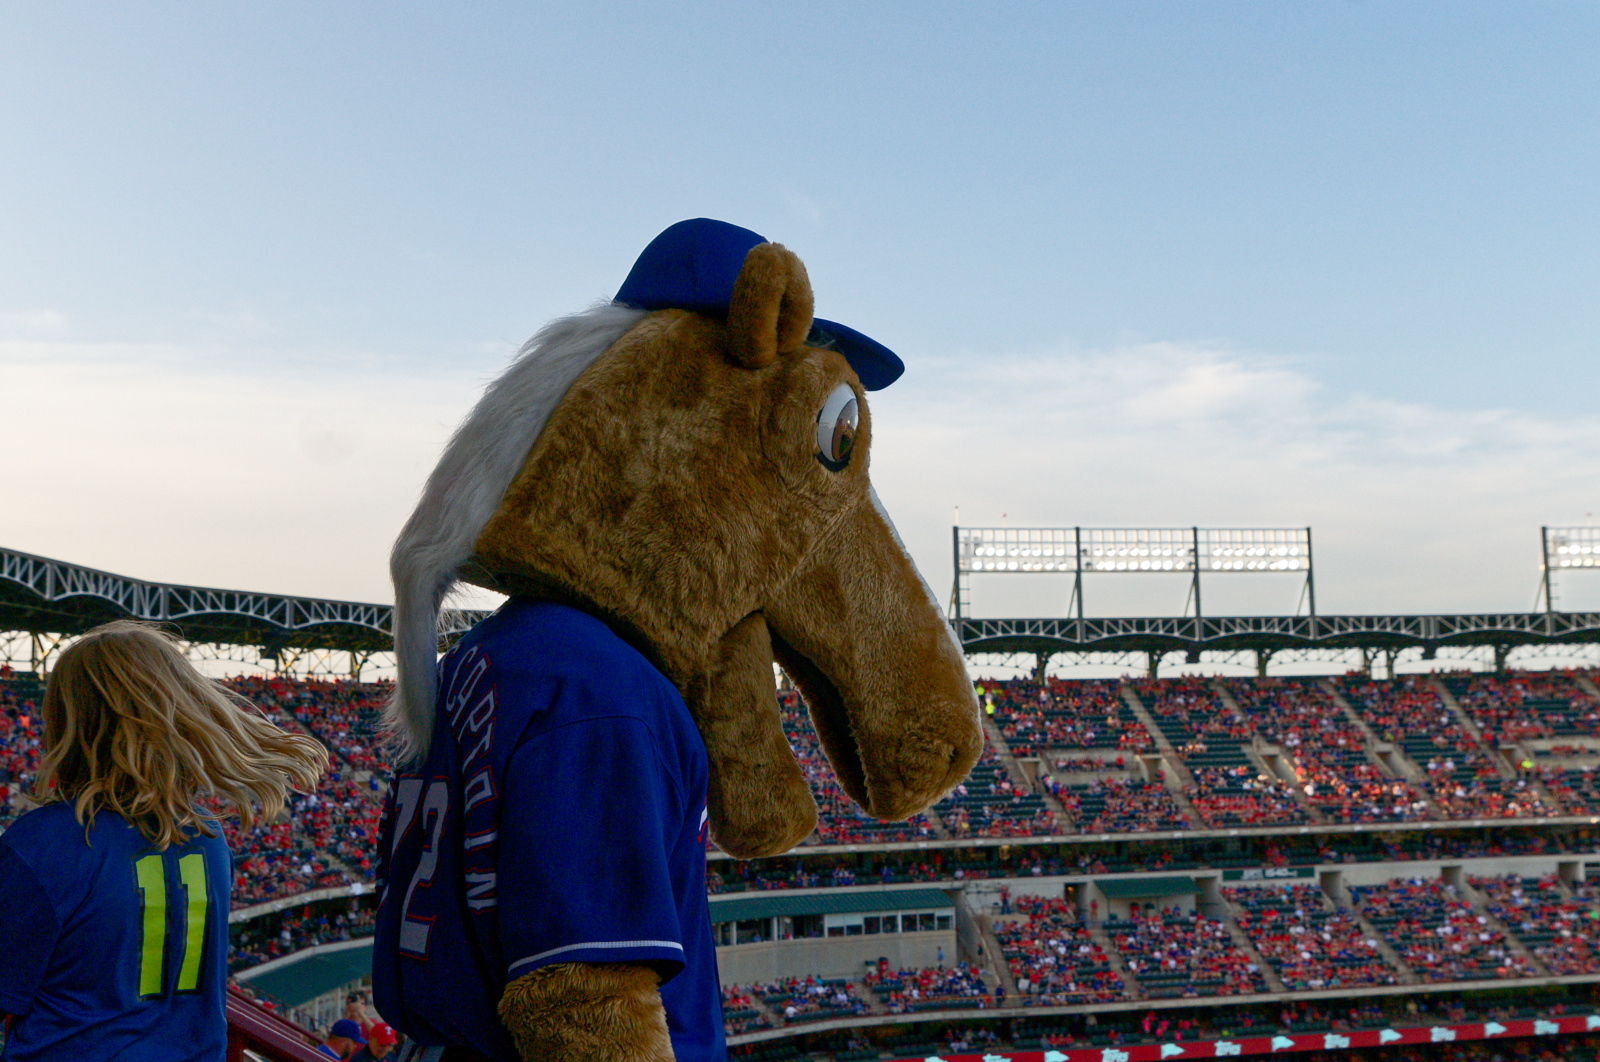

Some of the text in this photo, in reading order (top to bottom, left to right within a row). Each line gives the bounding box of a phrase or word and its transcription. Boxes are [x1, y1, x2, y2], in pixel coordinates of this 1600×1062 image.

[445, 643, 498, 913] CAPTAIN
[133, 848, 209, 998] 11
[376, 774, 449, 960] 72
[384, 1026, 393, 1035] T
